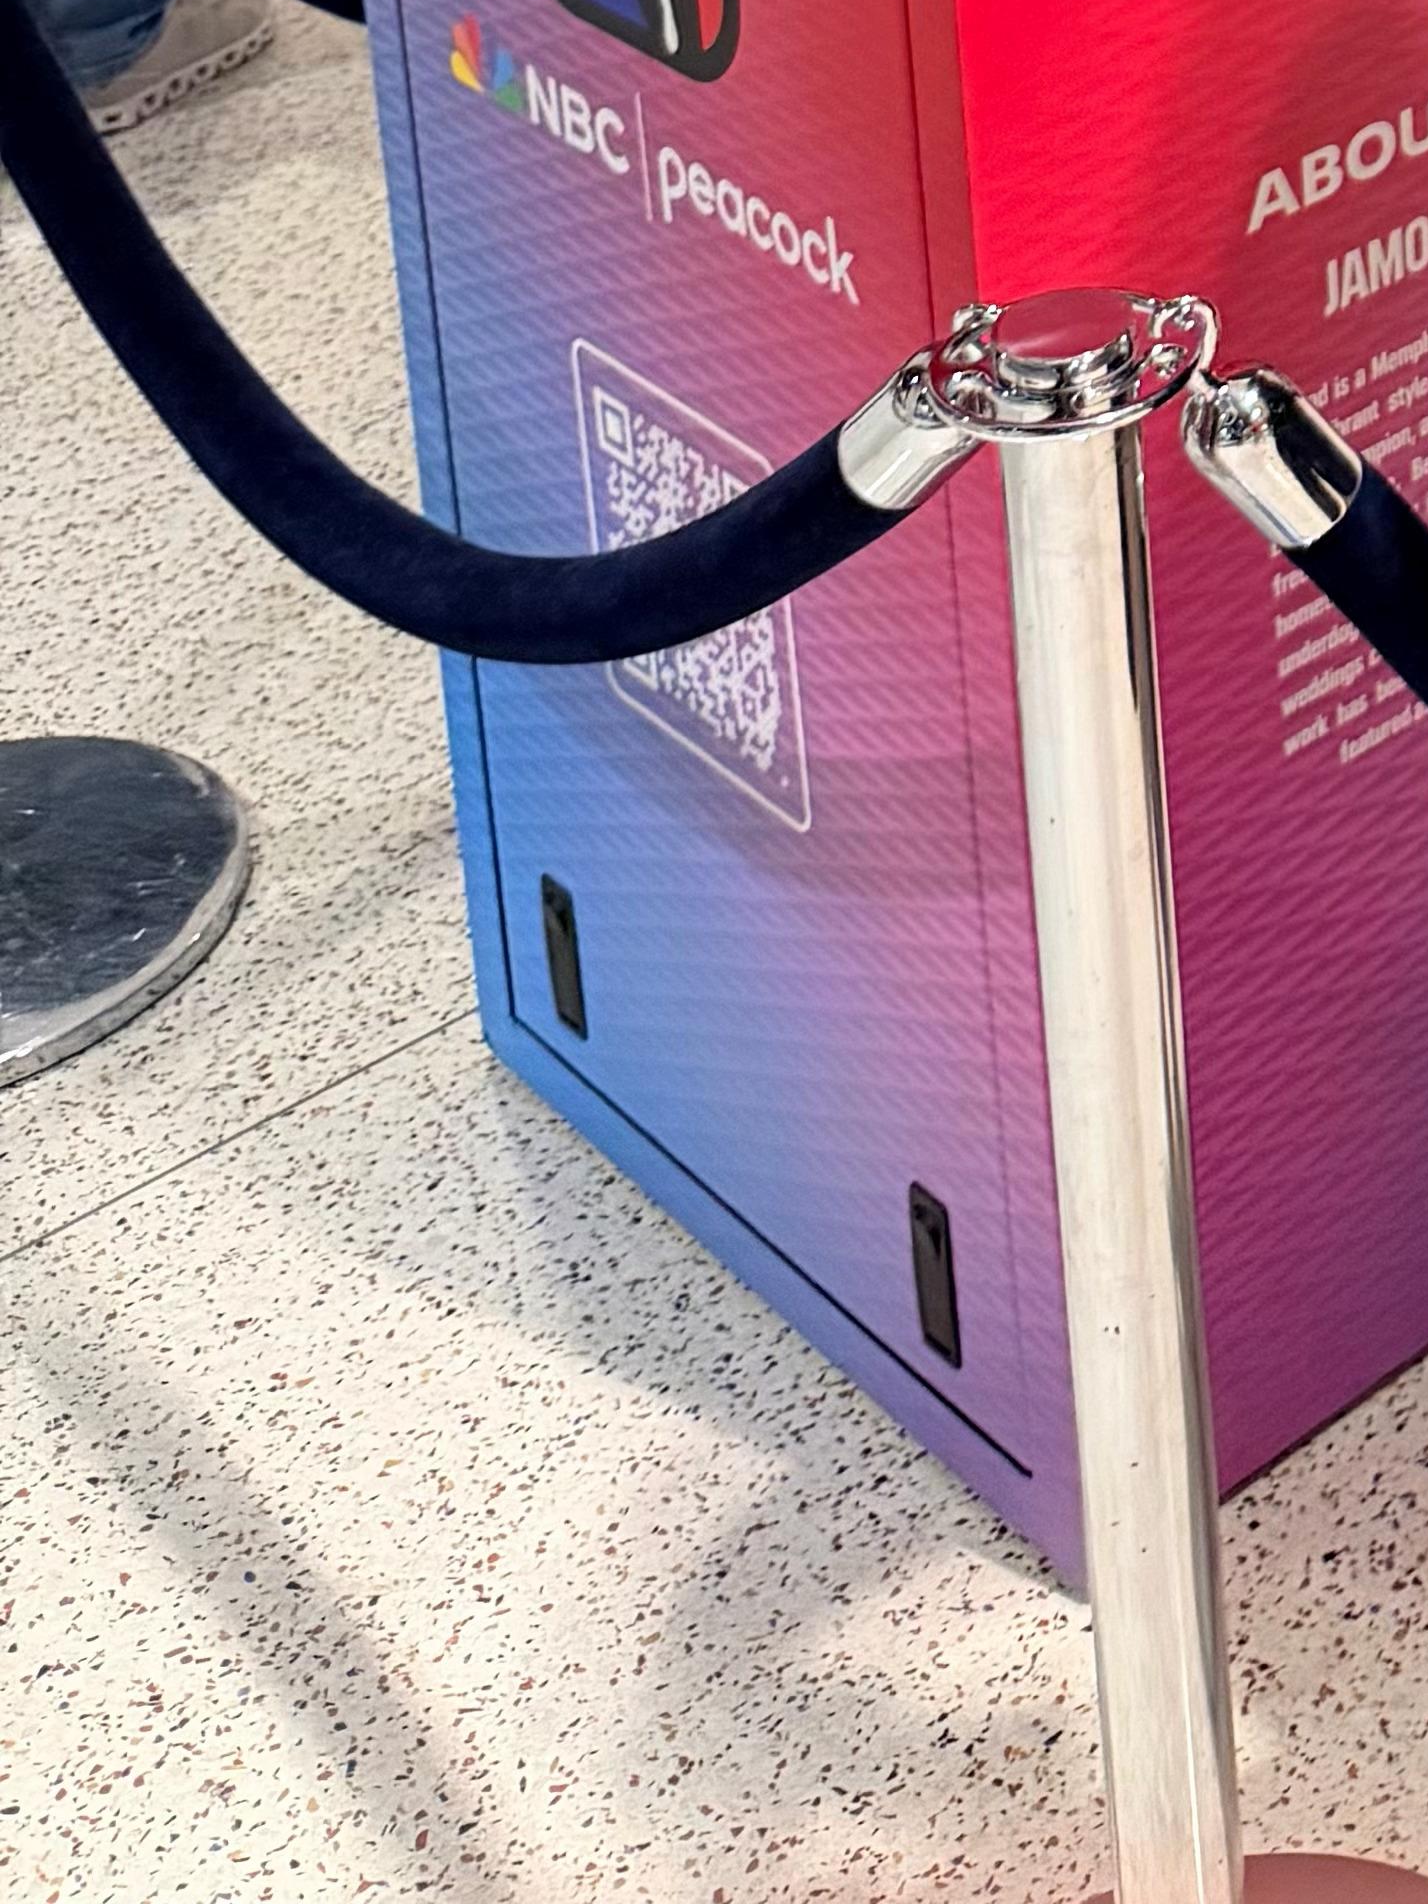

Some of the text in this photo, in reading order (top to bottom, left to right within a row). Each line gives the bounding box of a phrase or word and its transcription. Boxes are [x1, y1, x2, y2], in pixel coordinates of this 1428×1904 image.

[525, 64, 860, 306] NBC peacock
[1333, 375, 1350, 399] is
[1354, 368, 1367, 389] a
[1283, 714, 1330, 757] work
